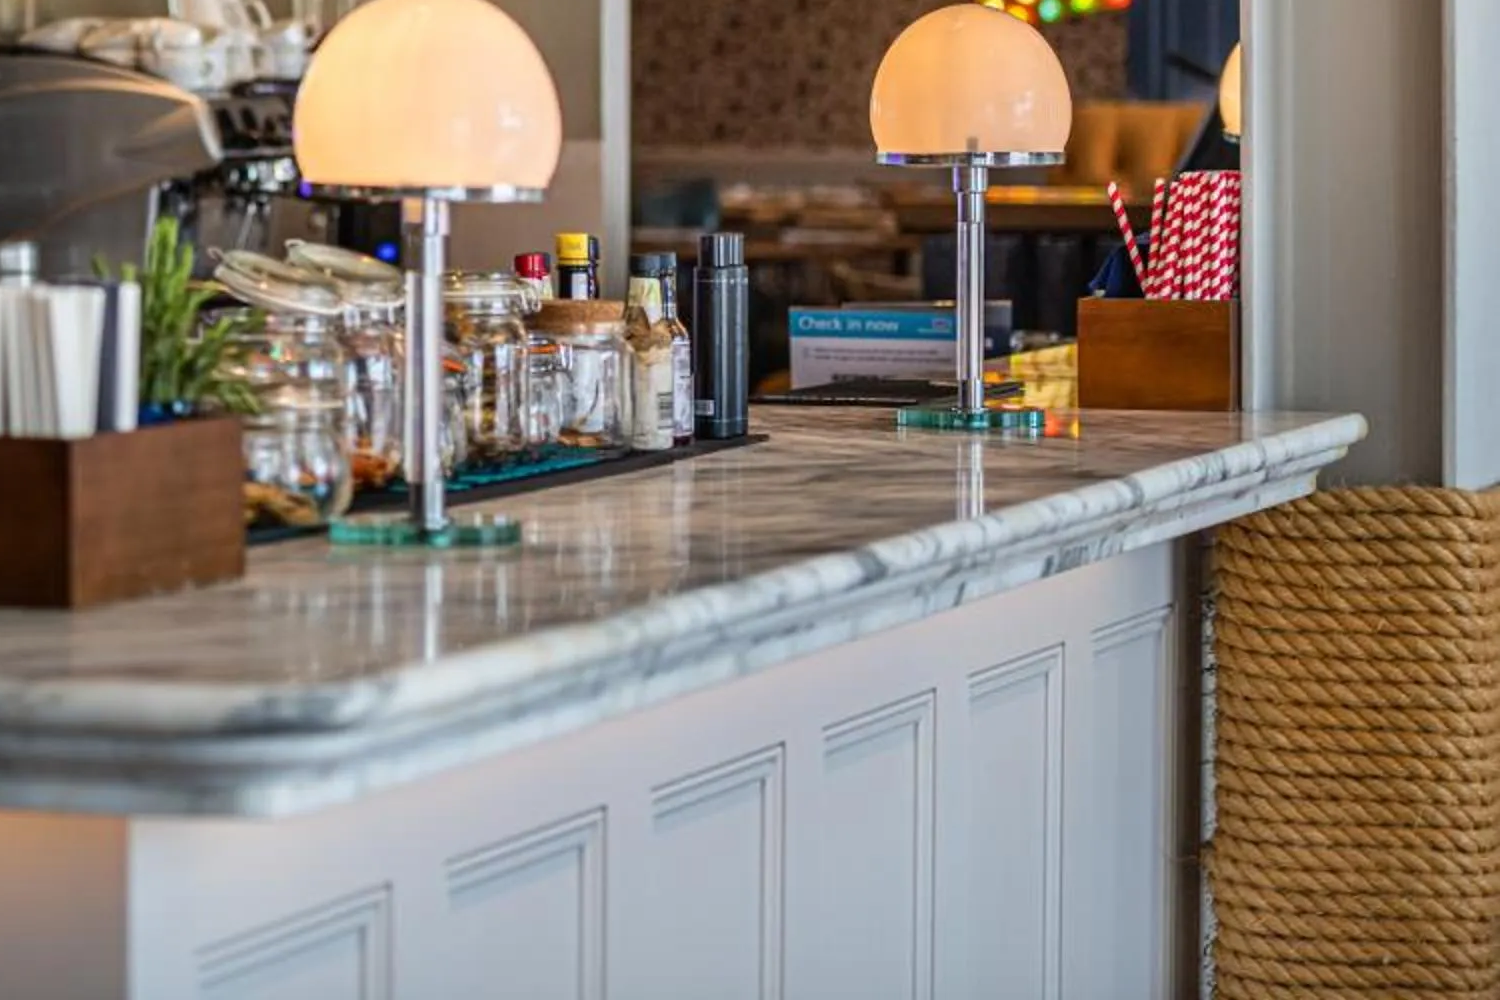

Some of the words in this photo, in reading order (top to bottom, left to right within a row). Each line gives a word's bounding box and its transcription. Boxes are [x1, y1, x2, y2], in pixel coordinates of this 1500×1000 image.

[798, 315, 842, 331] Check
[849, 318, 862, 331] in
[865, 320, 900, 332] now
